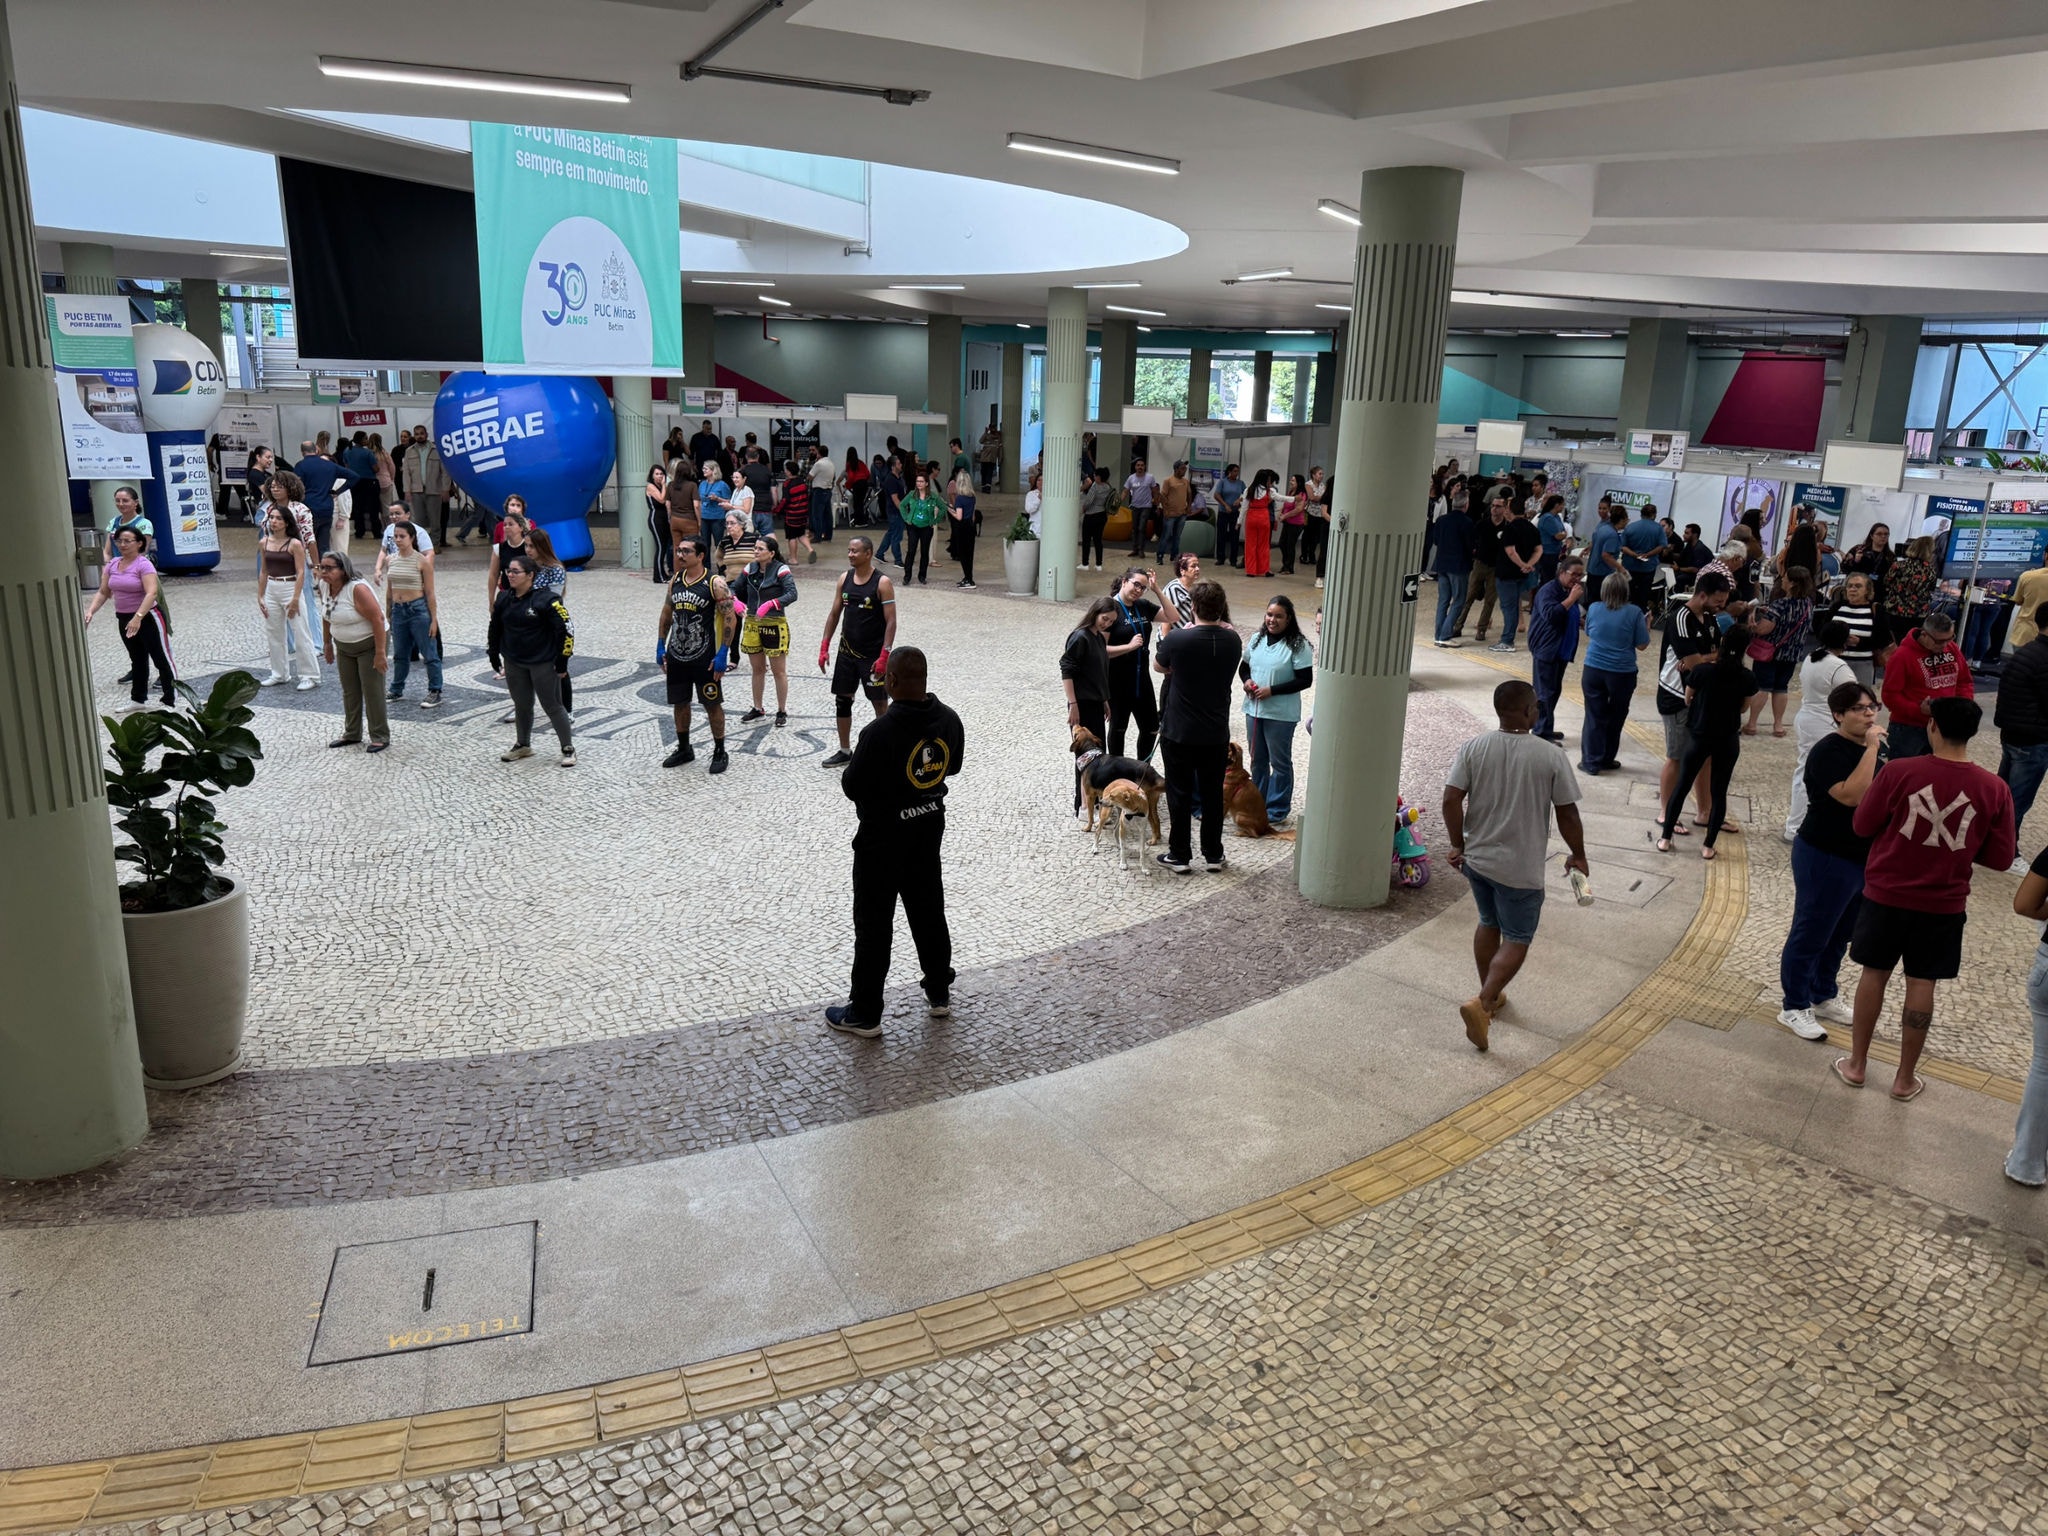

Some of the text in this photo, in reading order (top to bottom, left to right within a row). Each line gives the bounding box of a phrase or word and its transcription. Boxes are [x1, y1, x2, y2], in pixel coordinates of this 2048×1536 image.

[524, 126, 552, 143] PUC
[554, 128, 591, 153] Minas
[593, 136, 626, 163] Betim
[627, 150, 648, 169] está
[516, 150, 651, 196] sempre em movimento.
[539, 261, 588, 327] 30
[64, 312, 113, 321] PUC BETIM
[594, 303, 636, 319] PUC Minas
[566, 314, 588, 325] ANOS
[608, 322, 624, 331] Betim
[195, 360, 223, 382] CDL
[197, 384, 217, 395] Betim
[441, 411, 544, 457] SEBRAE
[194, 488, 208, 496] CDL
[1806, 488, 1832, 496] MEDICINA
[196, 503, 210, 511] CDL
[1634, 494, 1649, 507] MG
[1936, 502, 1978, 513] FISIOTERAPIA
[198, 518, 212, 526] SPC
[900, 801, 939, 820] COACH
[1899, 784, 1977, 852] NY
[388, 1315, 523, 1349] TELECOM
